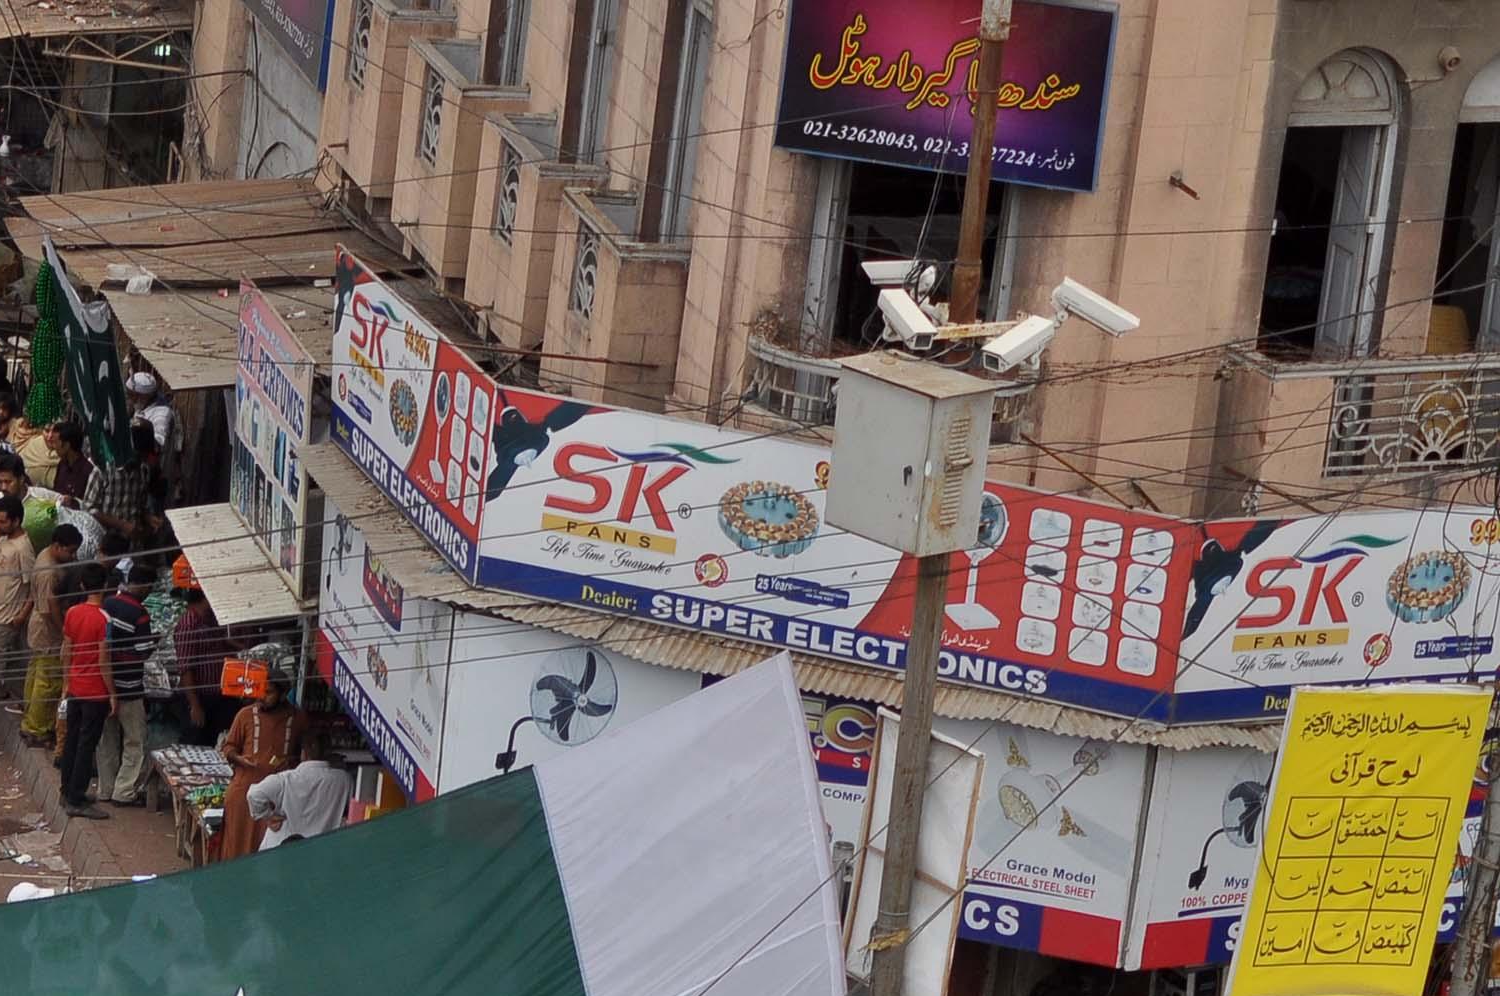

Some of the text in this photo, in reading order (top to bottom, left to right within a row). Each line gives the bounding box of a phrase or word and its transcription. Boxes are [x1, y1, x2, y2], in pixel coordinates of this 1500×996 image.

[351, 427, 389, 489] SUPER
[390, 469, 469, 570] ELECTRONICS
[544, 441, 691, 532] SK
[566, 520, 652, 550] FANS
[1235, 555, 1368, 629] SK
[650, 593, 775, 643] SUPER
[784, 620, 1049, 695] ELECTONICS
[1253, 631, 1329, 650] FANS
[334, 660, 360, 716] SUPER
[360, 700, 415, 793] ELECTRONICS
[971, 866, 1097, 901] ELECTRICAL STEEL SHEET
[1006, 858, 1097, 886] Grace Model
